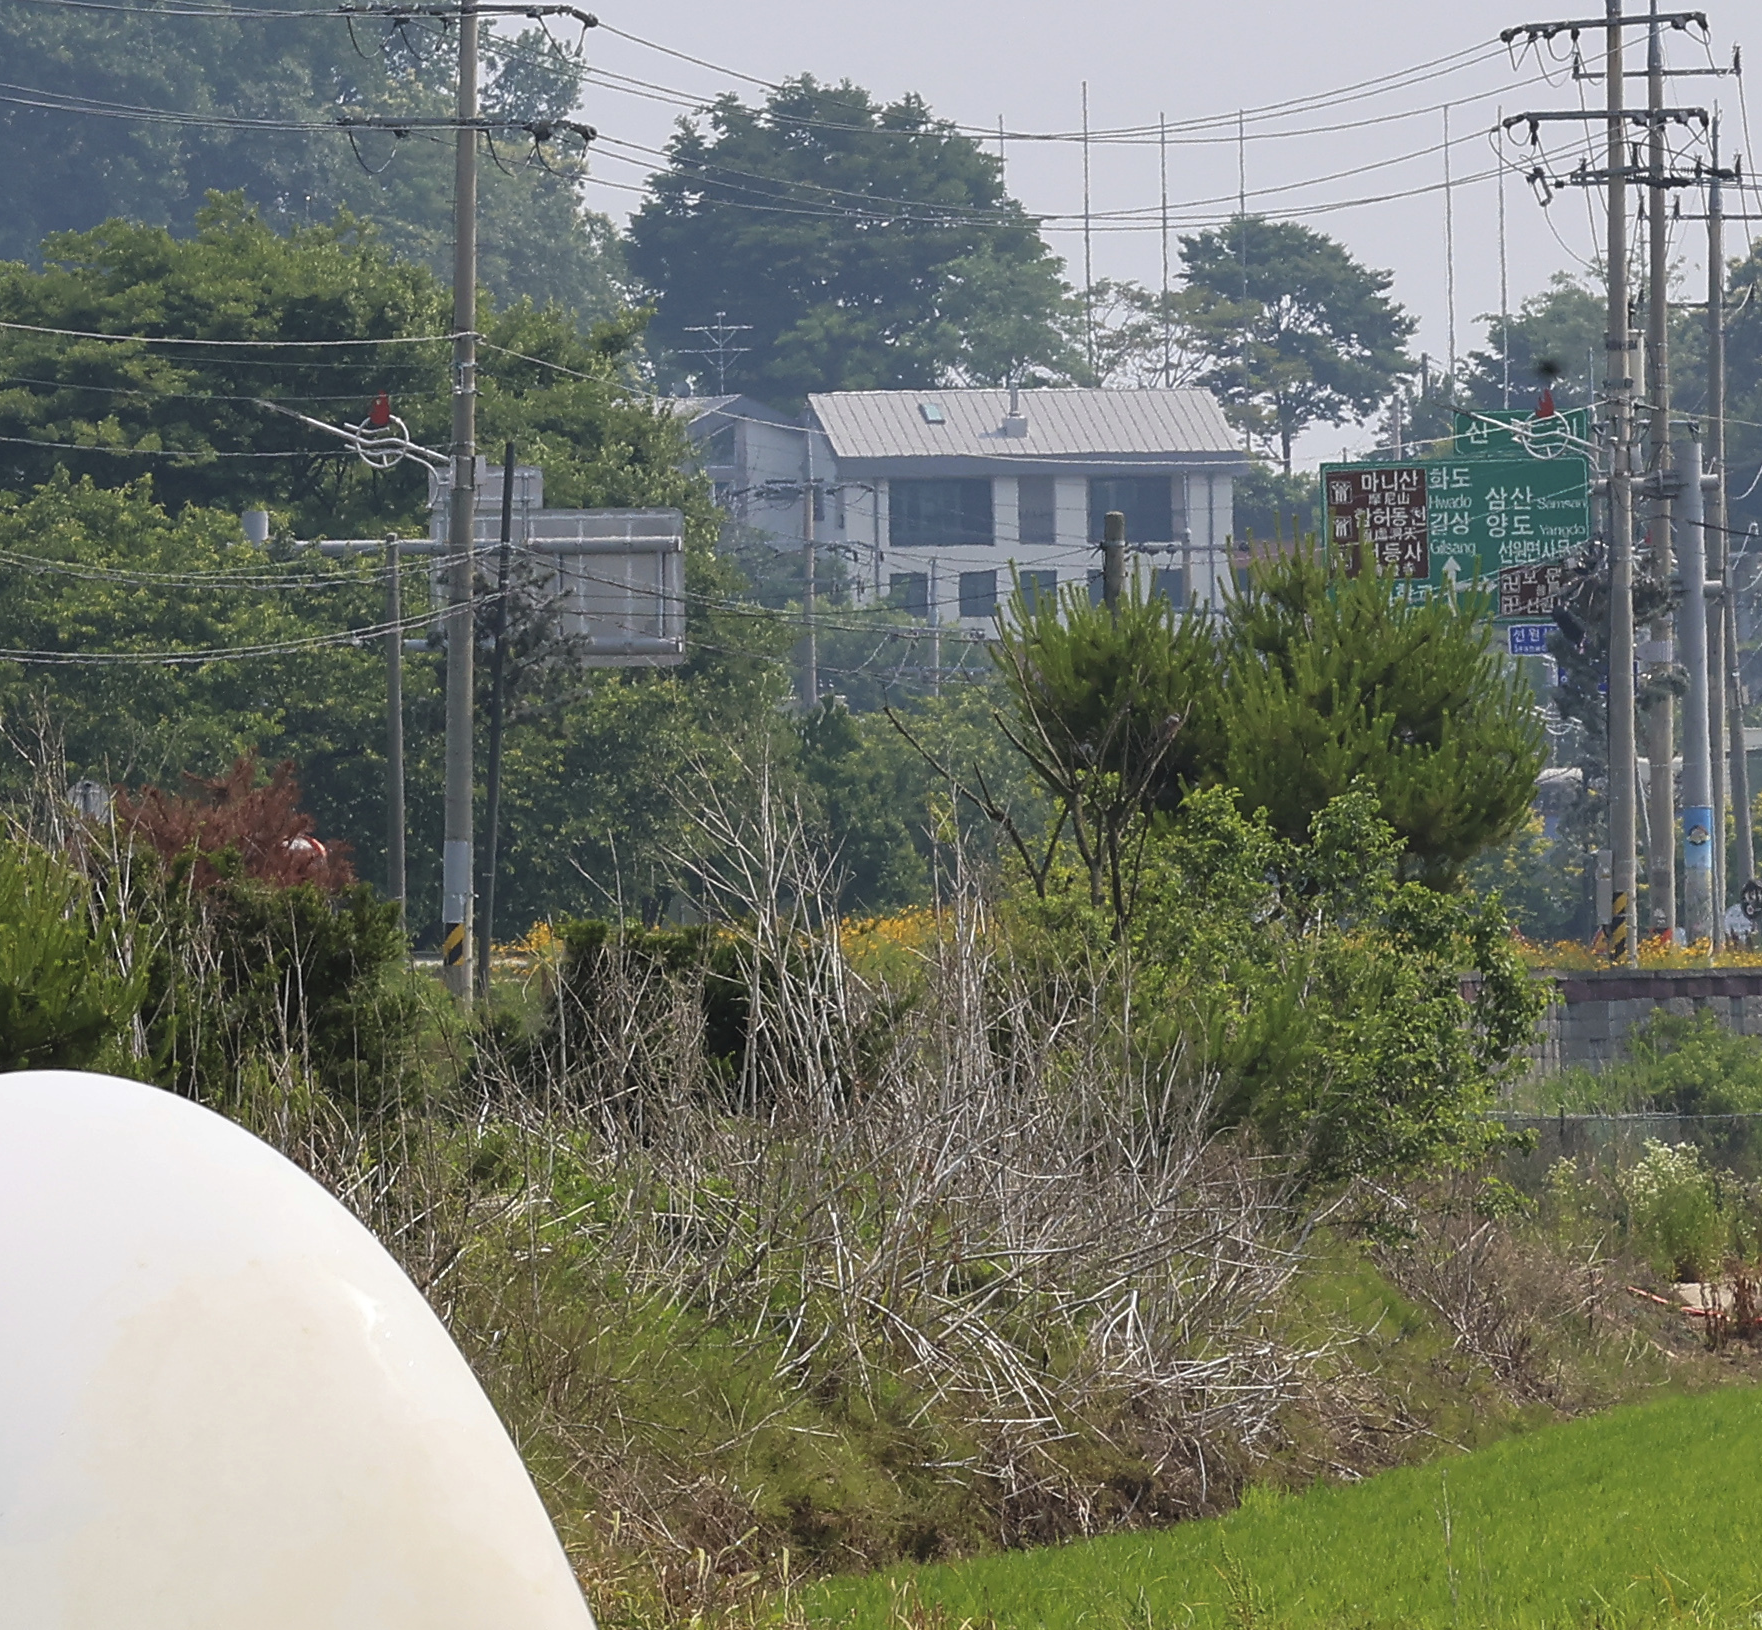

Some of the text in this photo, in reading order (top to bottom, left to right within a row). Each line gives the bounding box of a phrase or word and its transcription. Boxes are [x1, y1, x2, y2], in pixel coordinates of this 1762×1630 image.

[1361, 470, 1418, 492] 마니산
[1428, 466, 1472, 490] 화도
[1428, 494, 1472, 509] Hwado
[1485, 485, 1535, 510] 삼산
[1430, 511, 1469, 536] 길상
[1486, 512, 1586, 538] 양도 Yangdo
[1430, 539, 1477, 557] Gilsang
